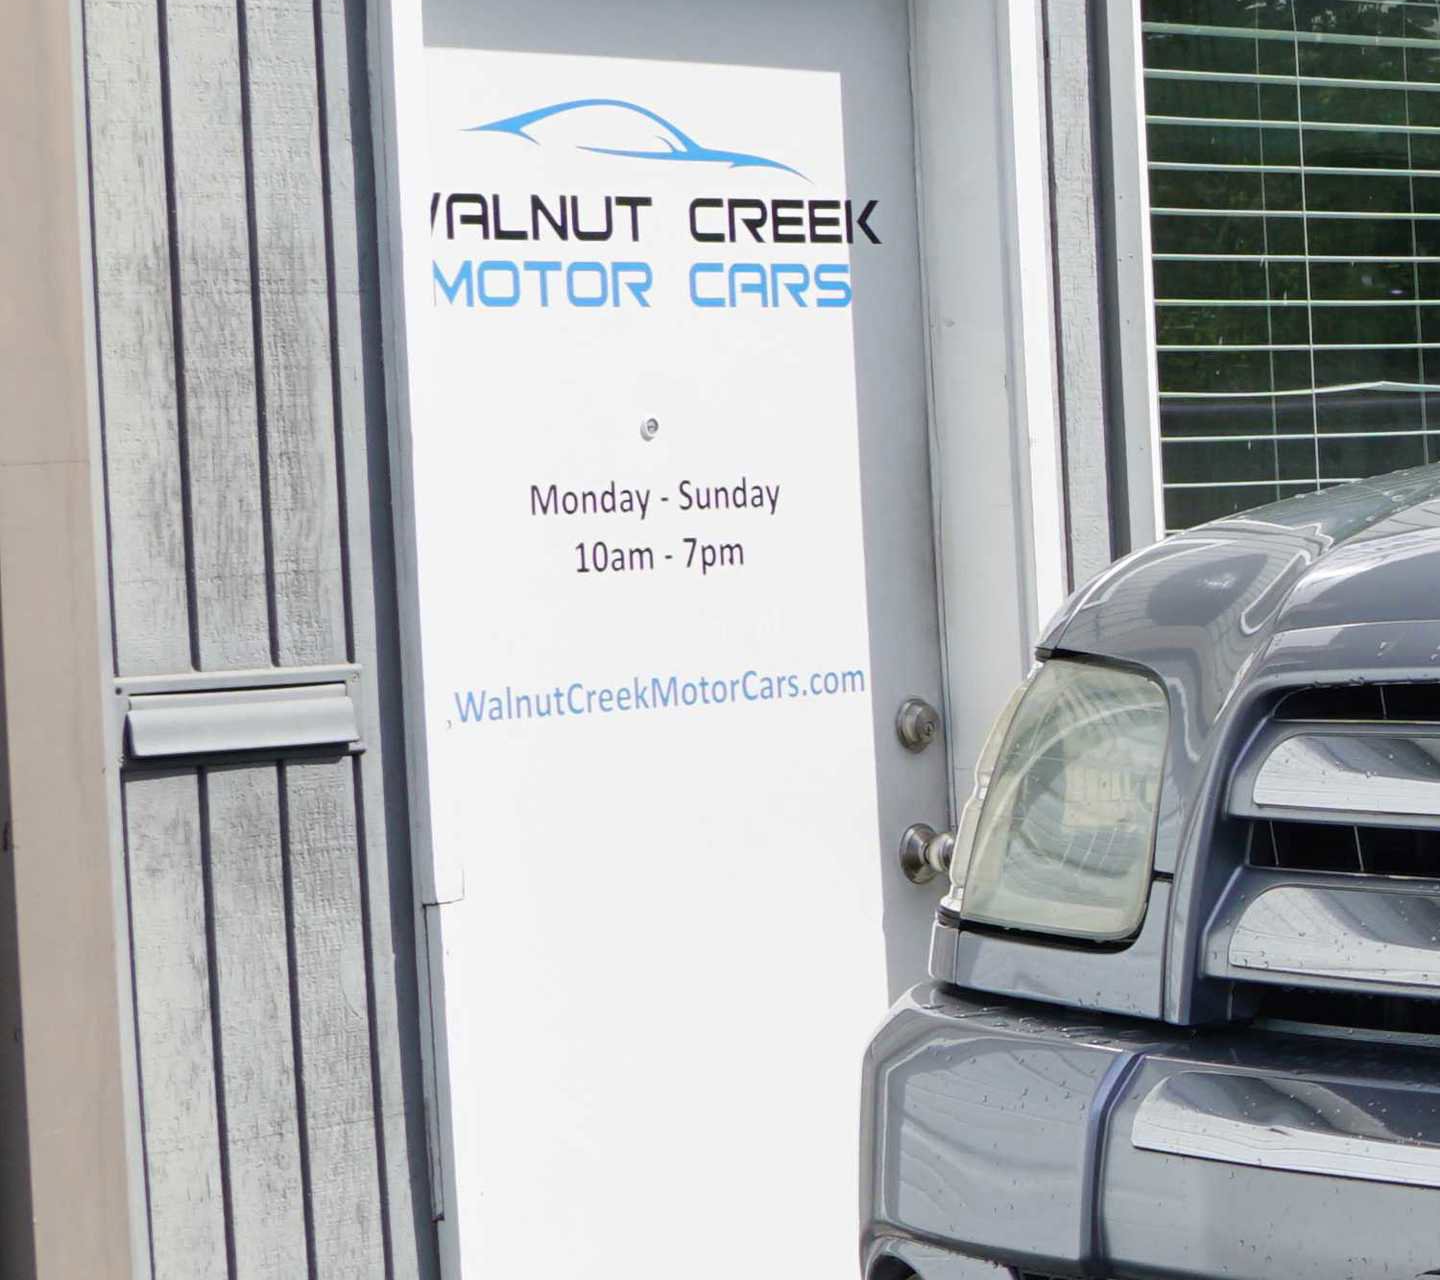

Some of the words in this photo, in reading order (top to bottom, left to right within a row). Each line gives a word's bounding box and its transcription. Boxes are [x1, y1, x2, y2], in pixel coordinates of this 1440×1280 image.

[689, 197, 882, 244] CREEK
[432, 260, 653, 308] MOTOR
[689, 263, 852, 308] CARS
[530, 481, 650, 520] Monday
[678, 477, 780, 515] Sunday
[575, 540, 654, 573] 10am
[682, 537, 744, 575] 7pm
[455, 669, 864, 723] WalnutCreekMotorCars.com
